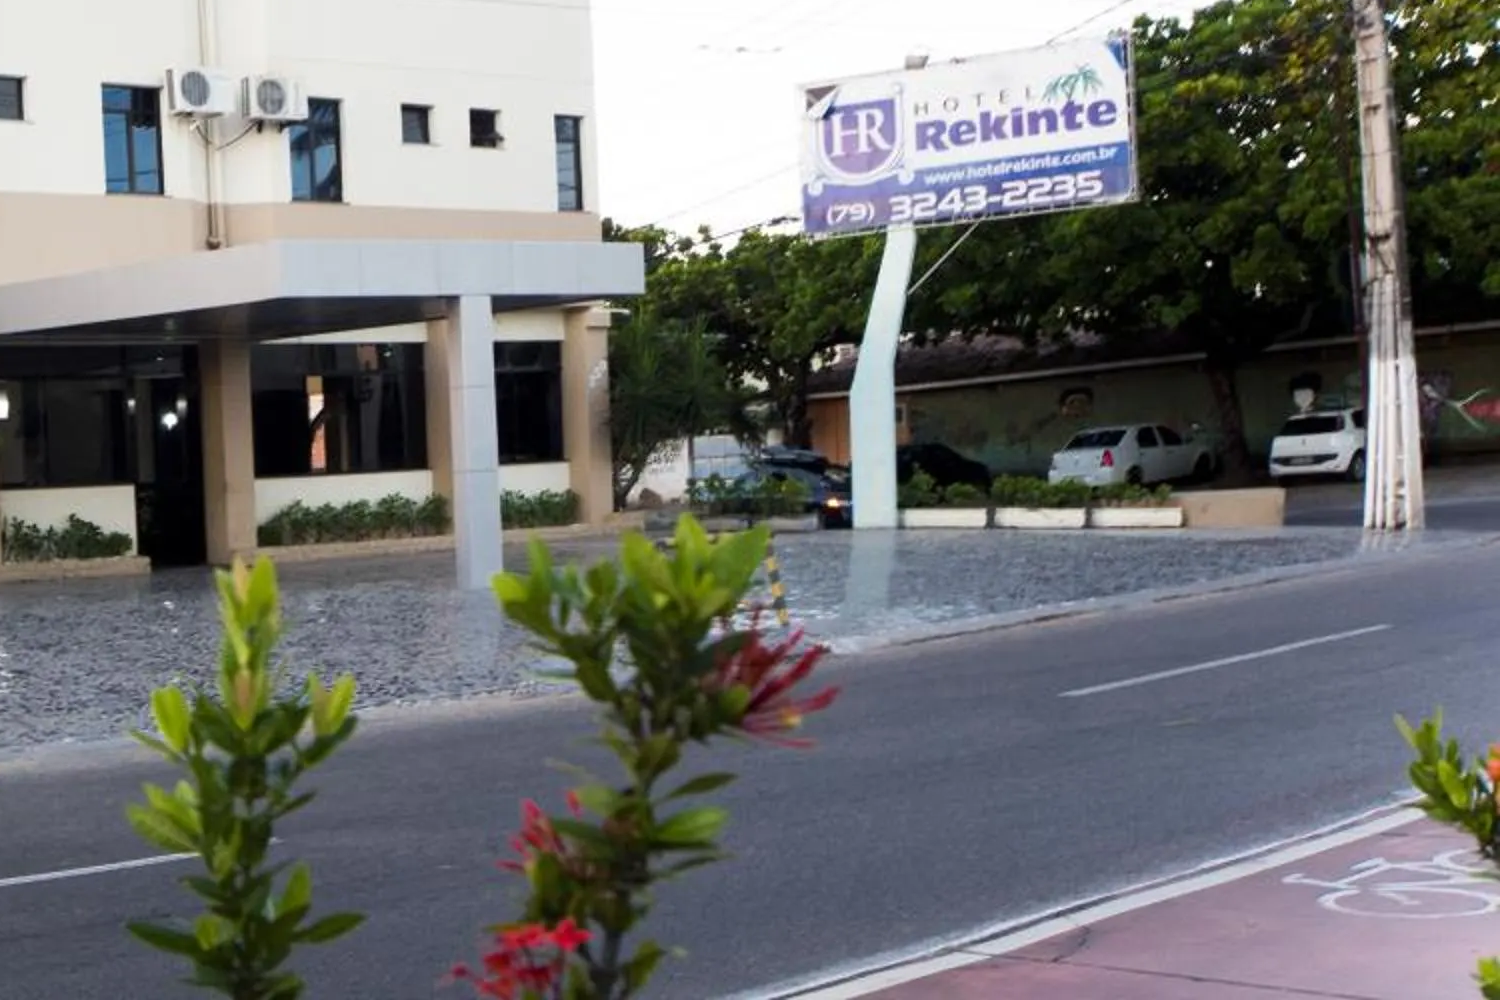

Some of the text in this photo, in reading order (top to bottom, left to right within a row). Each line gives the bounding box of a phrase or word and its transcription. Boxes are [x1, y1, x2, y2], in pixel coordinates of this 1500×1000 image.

[914, 87, 1032, 116] HOTEL
[915, 99, 1119, 152] Rekinte
[831, 107, 891, 158] HR
[923, 147, 1118, 185] www.hotelrekinte.com.br
[826, 170, 1104, 227] (79) 3243-2235
